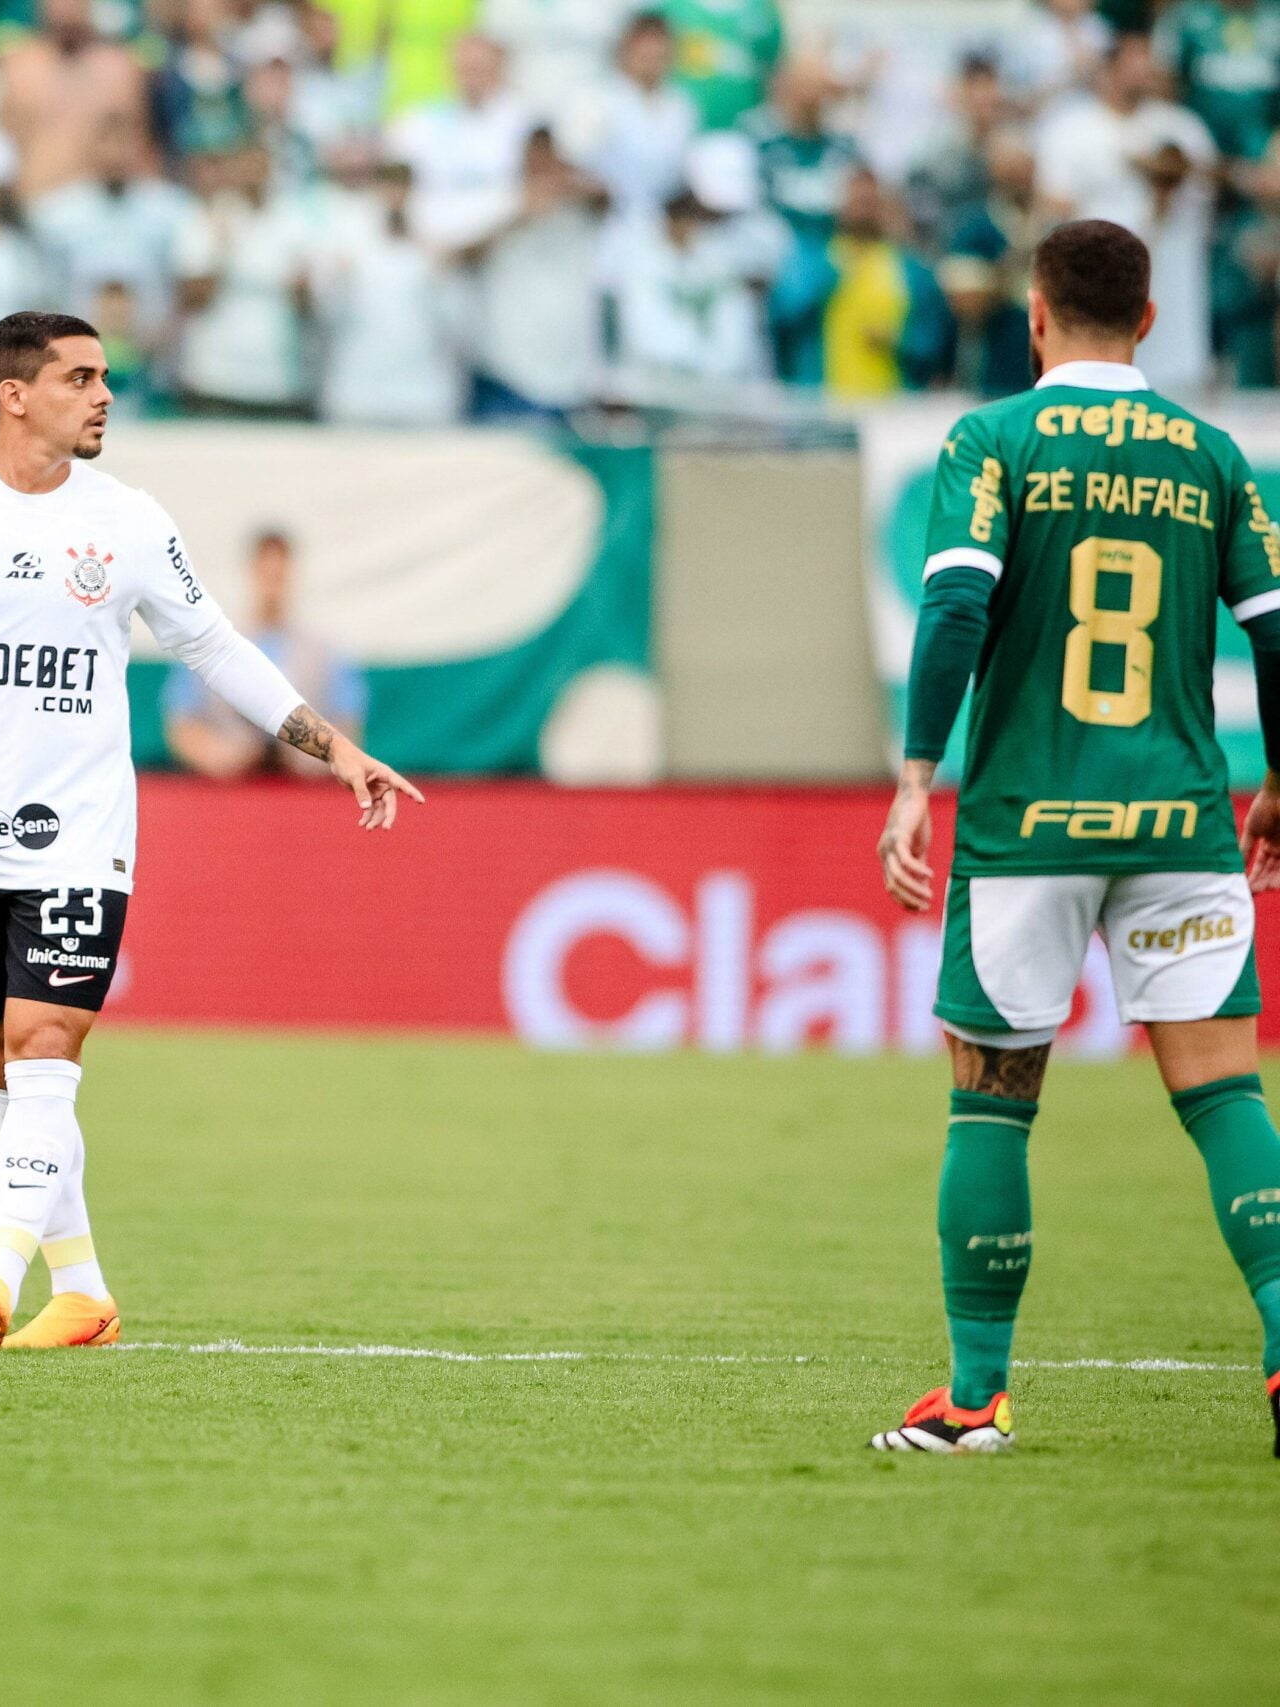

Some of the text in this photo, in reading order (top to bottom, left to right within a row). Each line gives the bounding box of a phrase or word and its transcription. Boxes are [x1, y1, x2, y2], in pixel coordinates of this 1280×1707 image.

[1035, 398, 1197, 451] crefisa
[1024, 467, 1215, 529] ZÉ RAFAEL
[5, 570, 45, 580] ALE
[171, 551, 202, 605] bmg
[1061, 535, 1163, 728] 8
[34, 696, 93, 714] .COM
[40, 887, 104, 935] 23
[1128, 915, 1234, 955] crefisa
[27, 948, 110, 969] UniCesumar
[6, 1157, 58, 1176] SCCP
